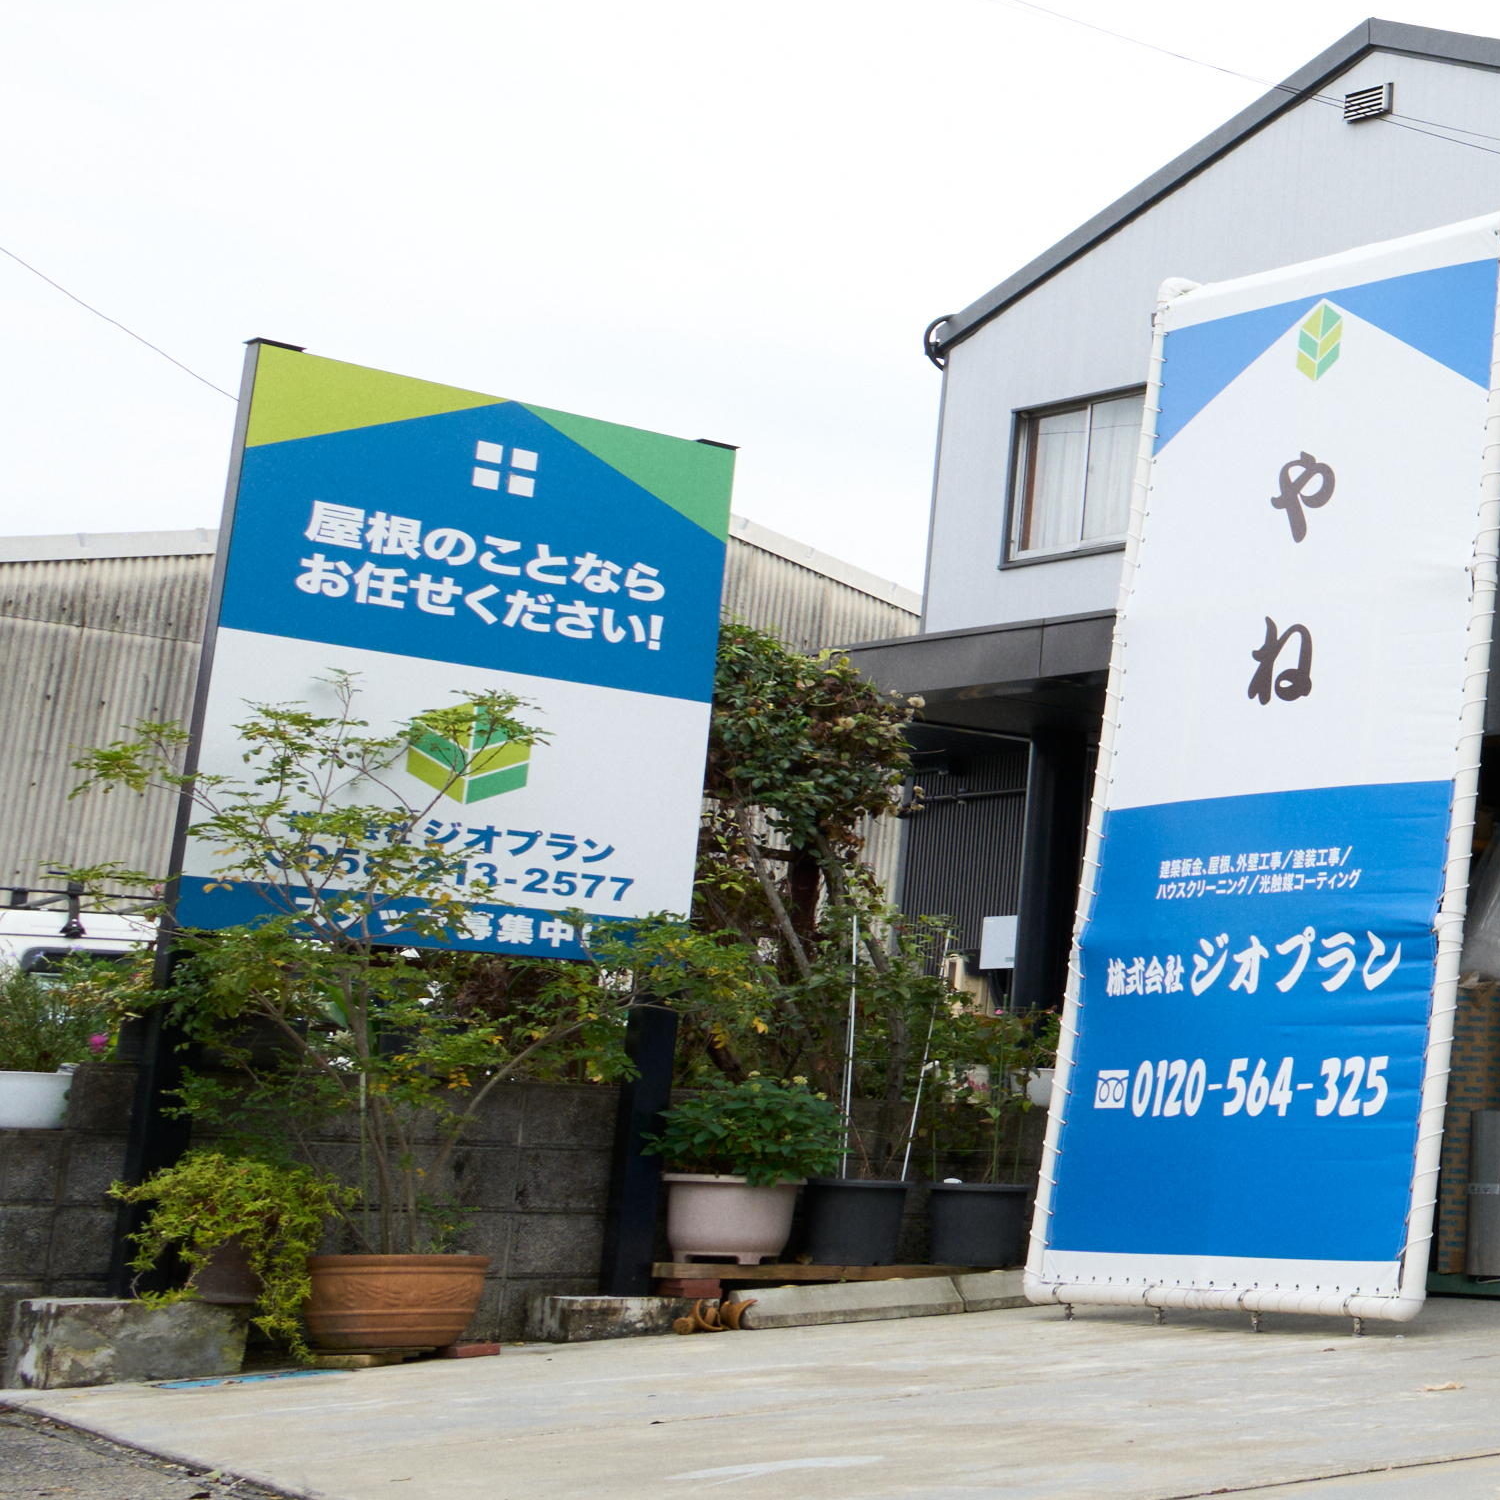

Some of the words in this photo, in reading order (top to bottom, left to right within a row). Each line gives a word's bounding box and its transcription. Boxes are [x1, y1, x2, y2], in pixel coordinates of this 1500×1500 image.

[304, 499, 666, 602] 屋根のことなら
[1247, 450, 1336, 706] やね
[295, 553, 664, 651] お任せください!
[1132, 1056, 1389, 1118] 0120-564-325
